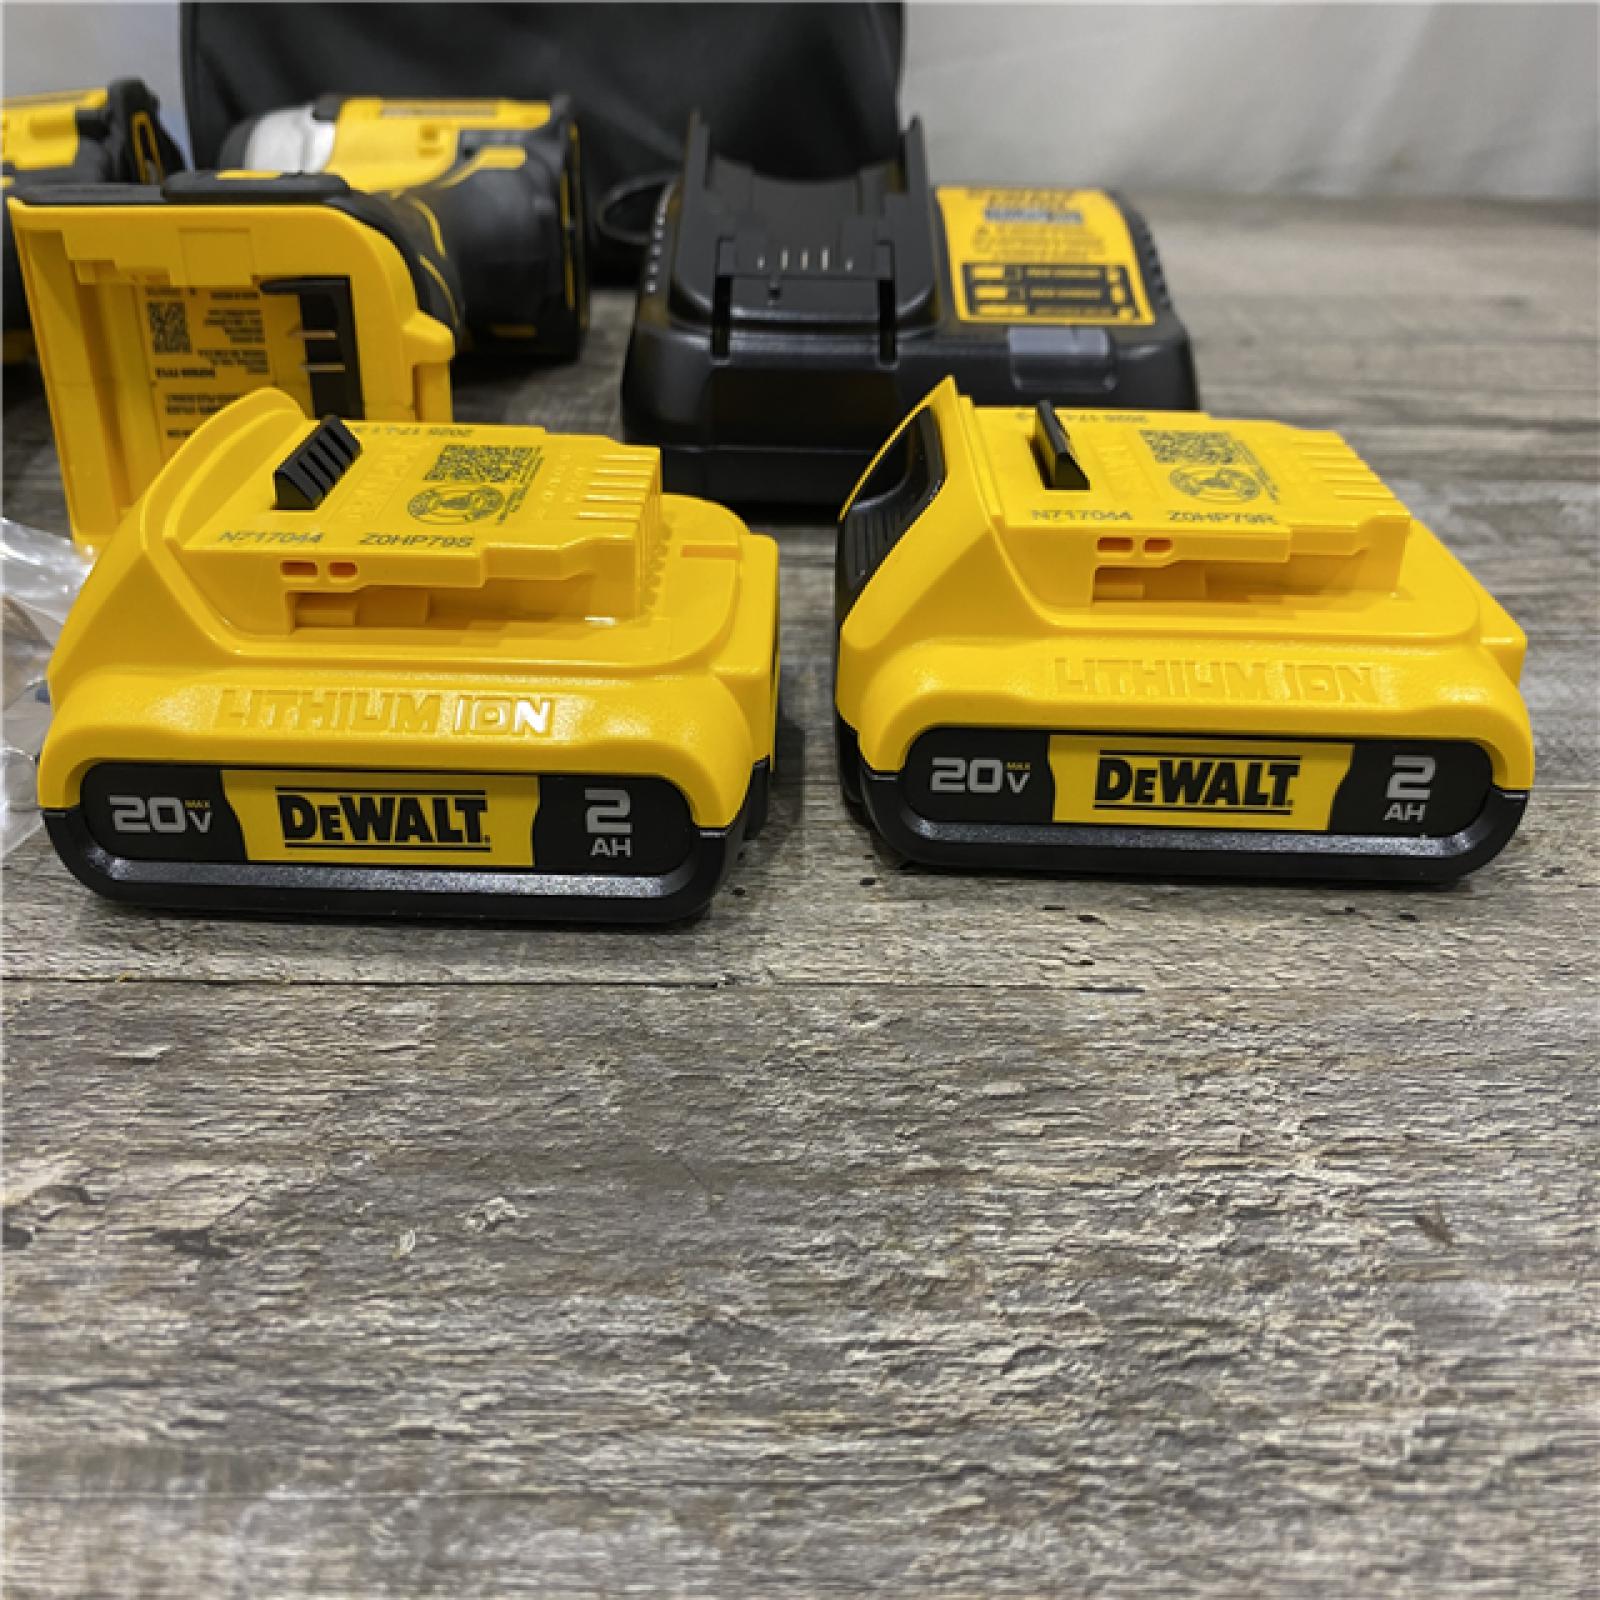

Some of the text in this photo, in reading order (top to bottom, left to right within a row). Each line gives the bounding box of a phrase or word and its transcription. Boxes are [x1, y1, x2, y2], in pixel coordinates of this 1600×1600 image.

[1053, 657, 1381, 704] LITHIUM ION
[214, 687, 554, 735] LITHIUM ION
[1096, 759, 1299, 807] DEWALT
[1385, 755, 1436, 801] 2
[276, 794, 490, 844] DEWALT
[584, 788, 633, 833] 2
[1383, 803, 1426, 822] AH
[590, 838, 631, 858] AH
